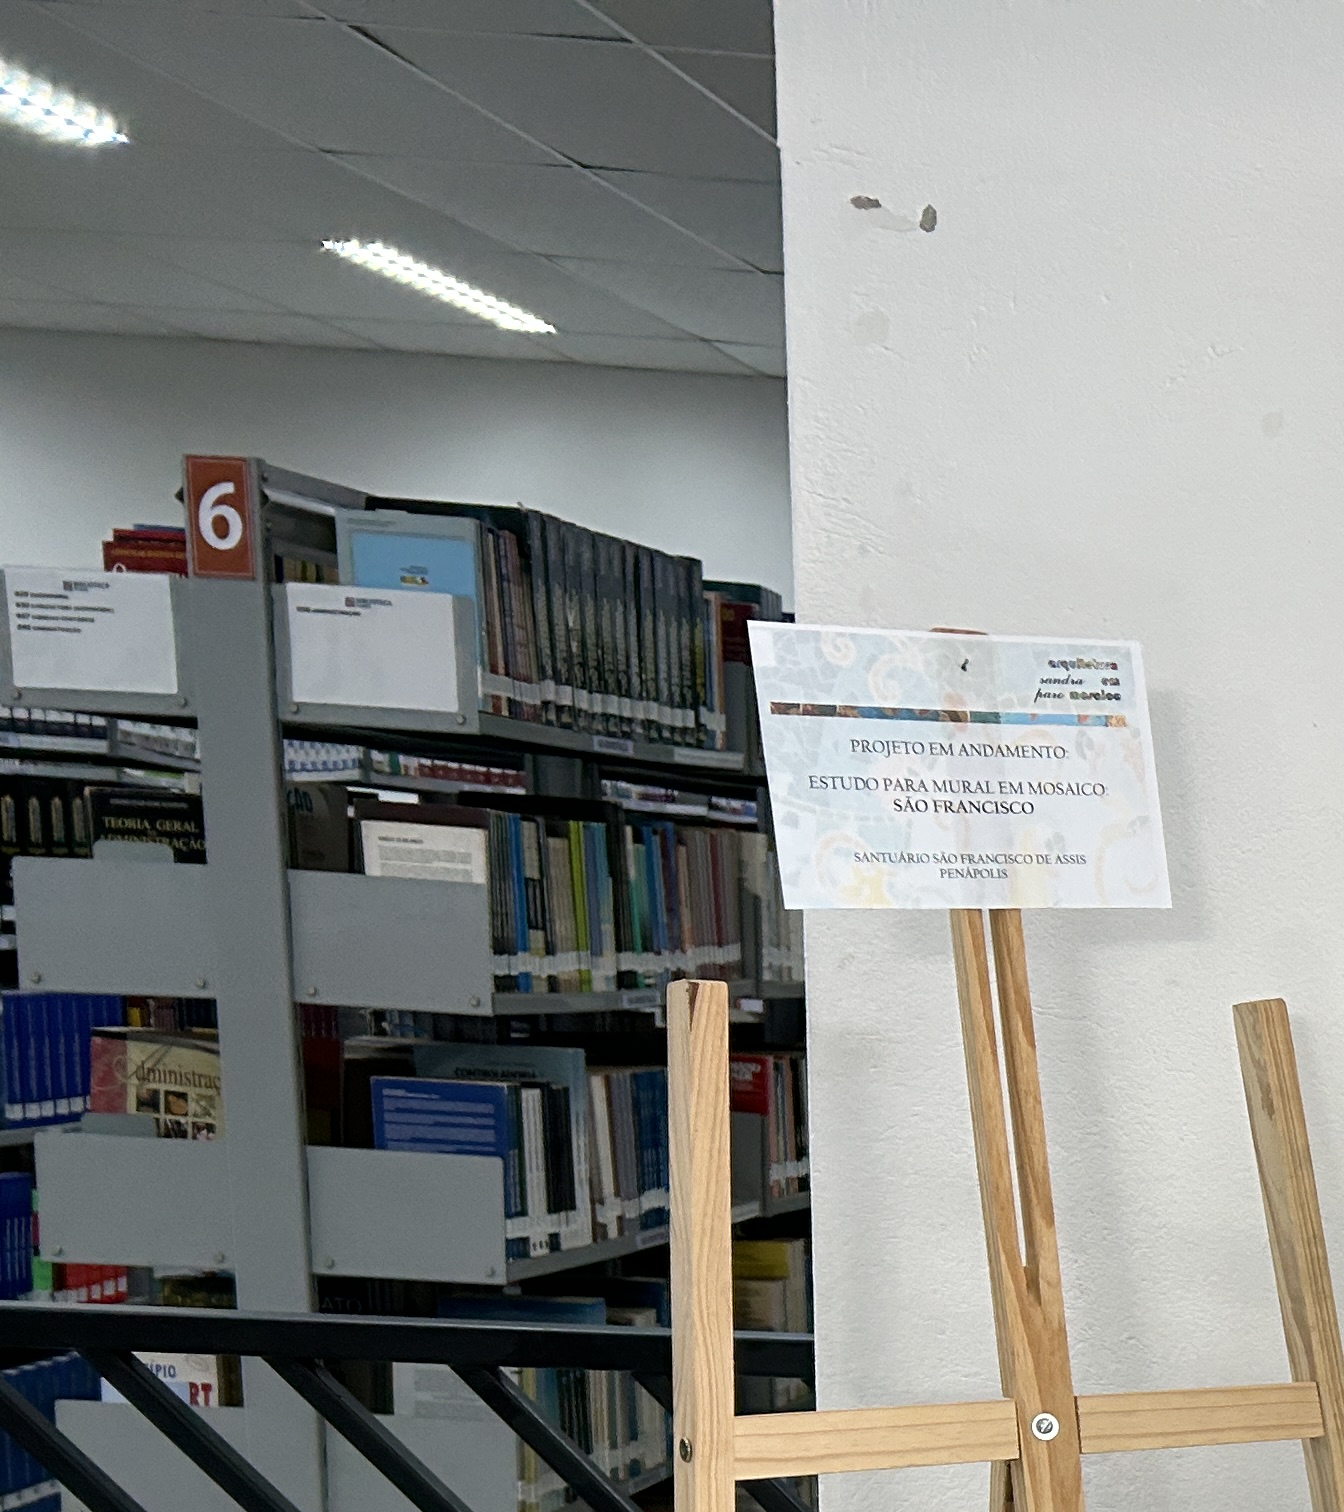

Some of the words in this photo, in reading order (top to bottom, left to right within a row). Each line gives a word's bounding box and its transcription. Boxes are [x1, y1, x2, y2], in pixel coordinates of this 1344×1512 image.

[197, 481, 243, 550] 6
[850, 739, 924, 758] PROJETO
[929, 741, 955, 757] EM
[959, 743, 1070, 759] ANDAMENTO:
[808, 775, 878, 791] ESTUDO
[883, 778, 928, 793] PARA
[932, 779, 994, 794] MURAL
[999, 781, 1024, 795] EM
[1028, 782, 1109, 797] MOSAICO:
[893, 796, 928, 813] SÃO
[933, 799, 1034, 816] FRANCISCO
[102, 815, 151, 830] TEORIA
[156, 819, 200, 833] GERAL
[854, 851, 929, 864] SANTUÁRIO
[933, 851, 957, 864] SÃO
[960, 853, 1033, 864] FRANCISCO
[1035, 854, 1051, 864] DE
[1054, 854, 1086, 865] ASSIS
[939, 866, 1008, 879] PENÁPOLIS
